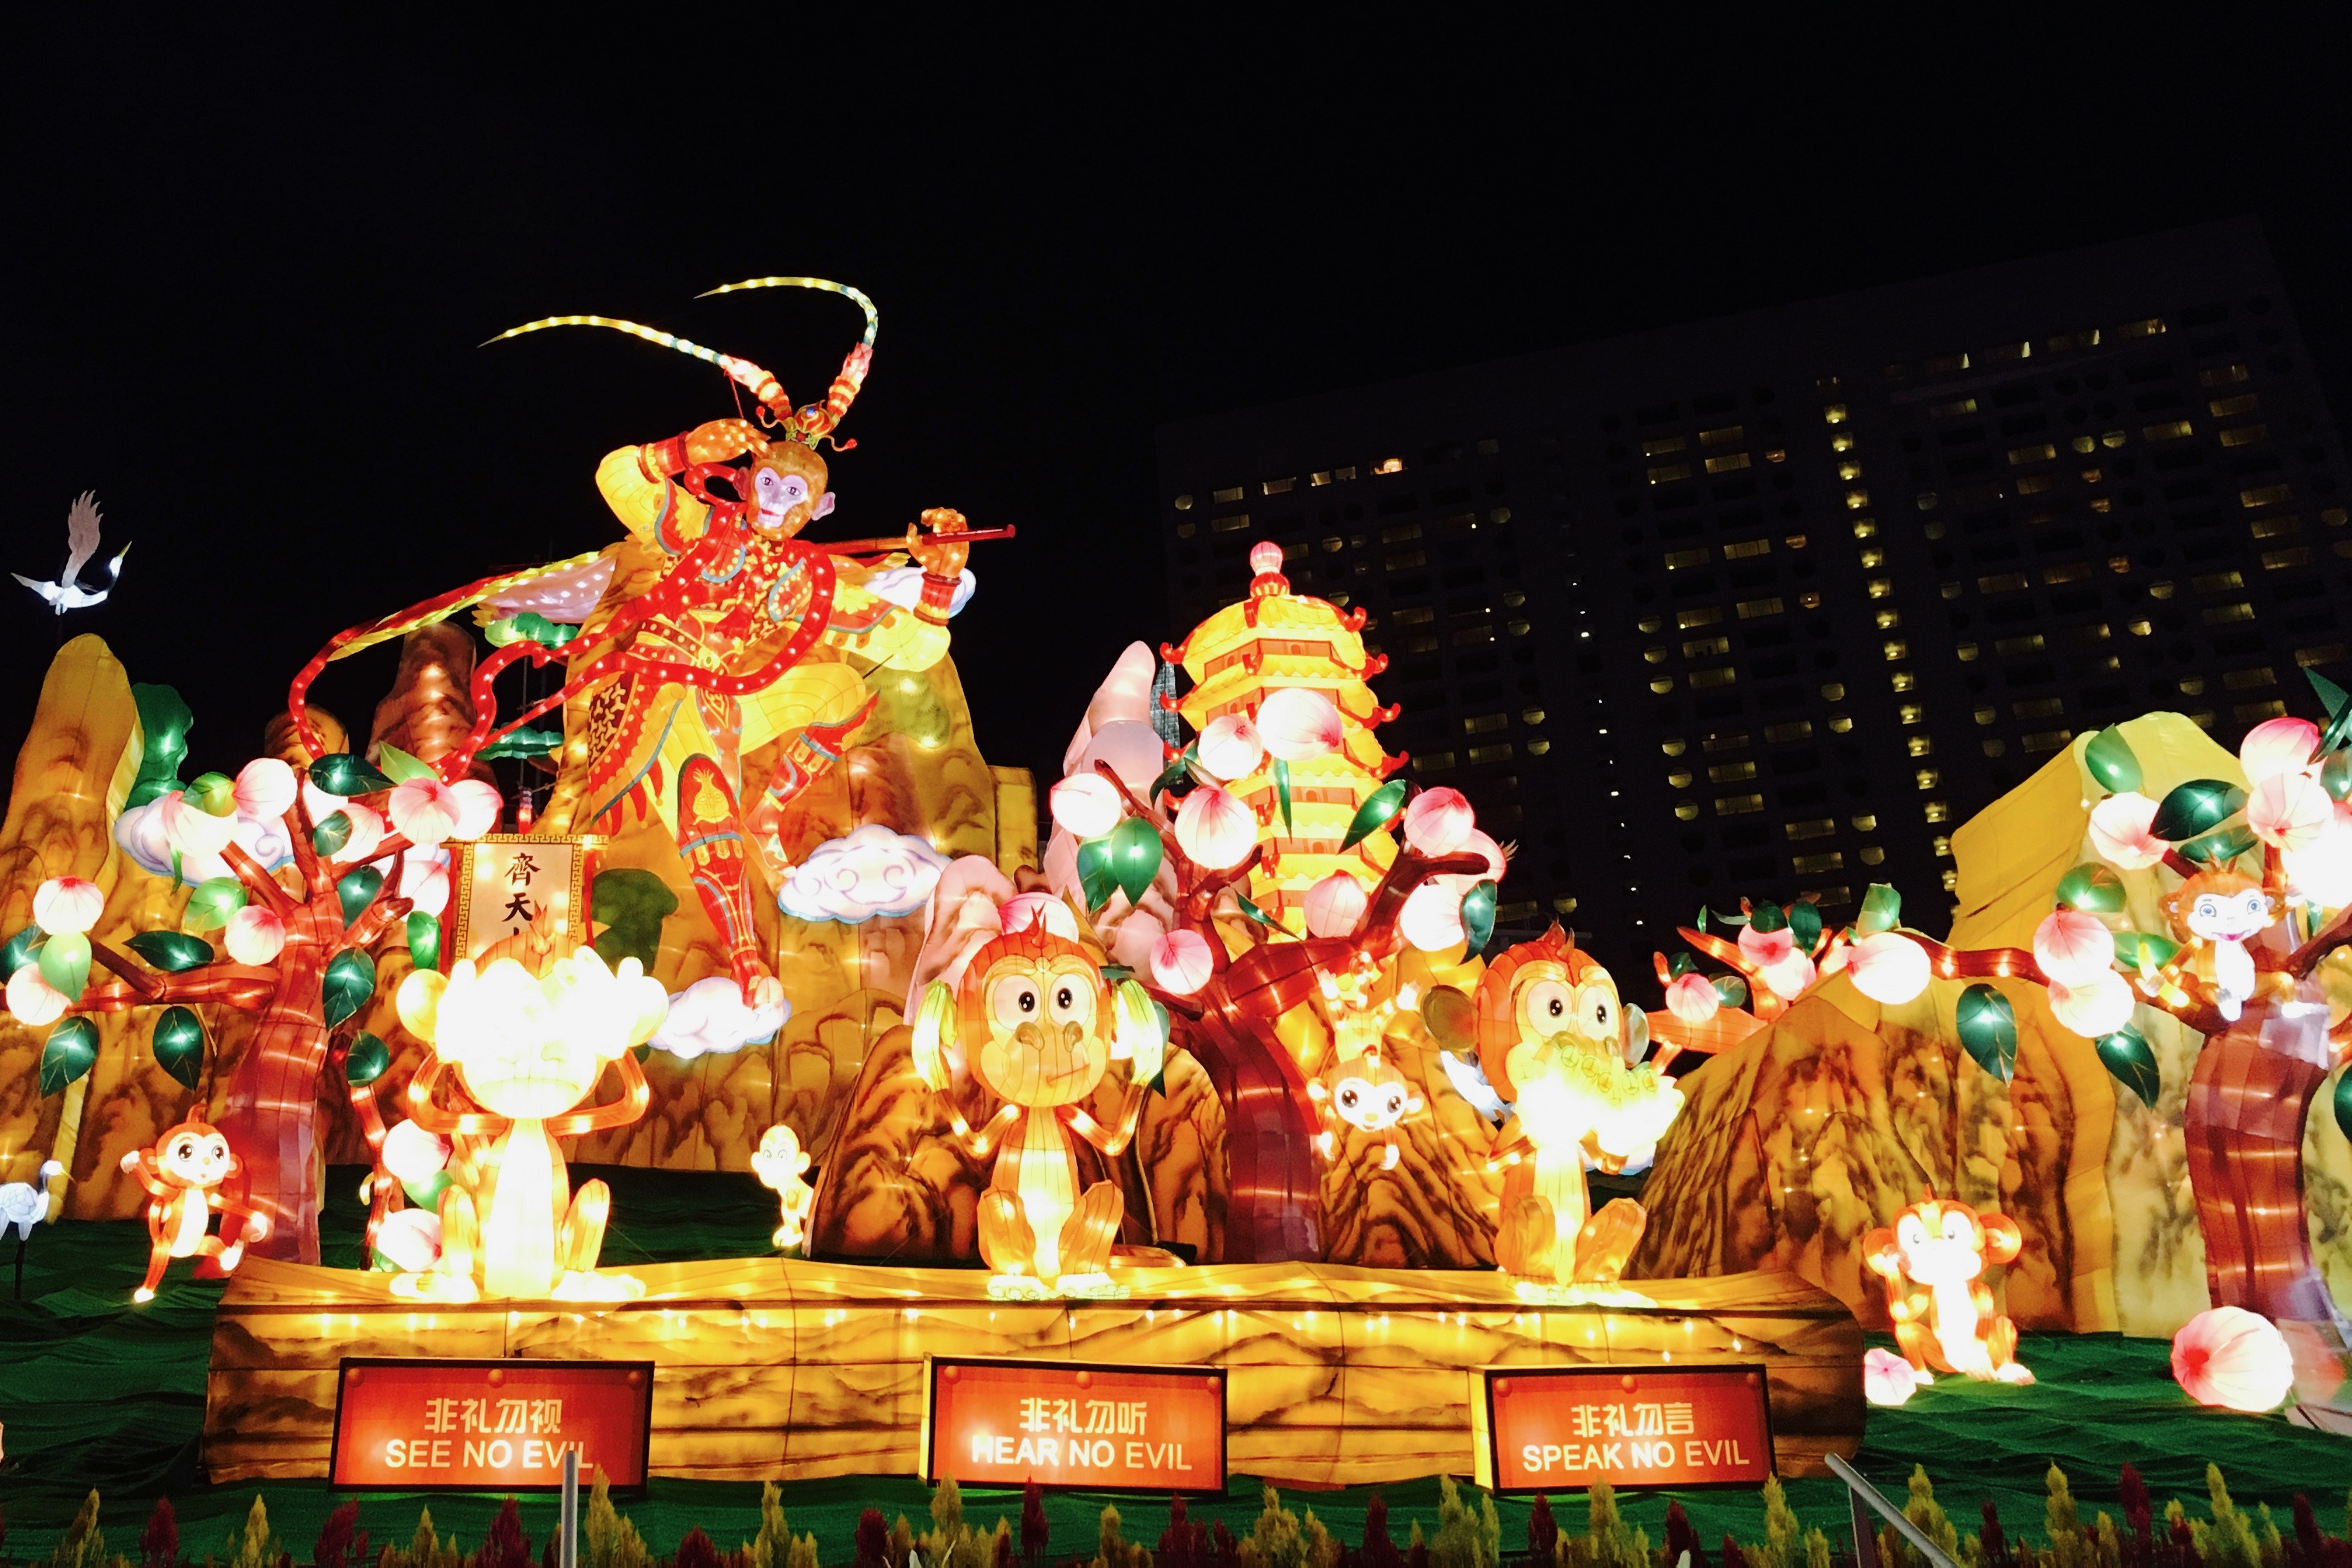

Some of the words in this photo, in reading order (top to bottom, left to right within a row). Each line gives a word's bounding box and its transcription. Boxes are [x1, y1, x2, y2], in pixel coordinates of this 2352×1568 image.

[501, 852, 541, 937] 齊天
[425, 1398, 562, 1434] 非礼勿视
[1020, 1398, 1147, 1435] 非礼勿听
[1571, 1402, 1695, 1438] 非礼勿言
[385, 1440, 451, 1468] SEE
[463, 1440, 513, 1468] NO
[972, 1435, 1060, 1466] HEAR
[1069, 1440, 1115, 1468] NO
[1125, 1442, 1193, 1470] EVIL
[1523, 1442, 1624, 1472] SPEAK
[1631, 1440, 1676, 1468] NO
[1685, 1439, 1750, 1467] EVIL
